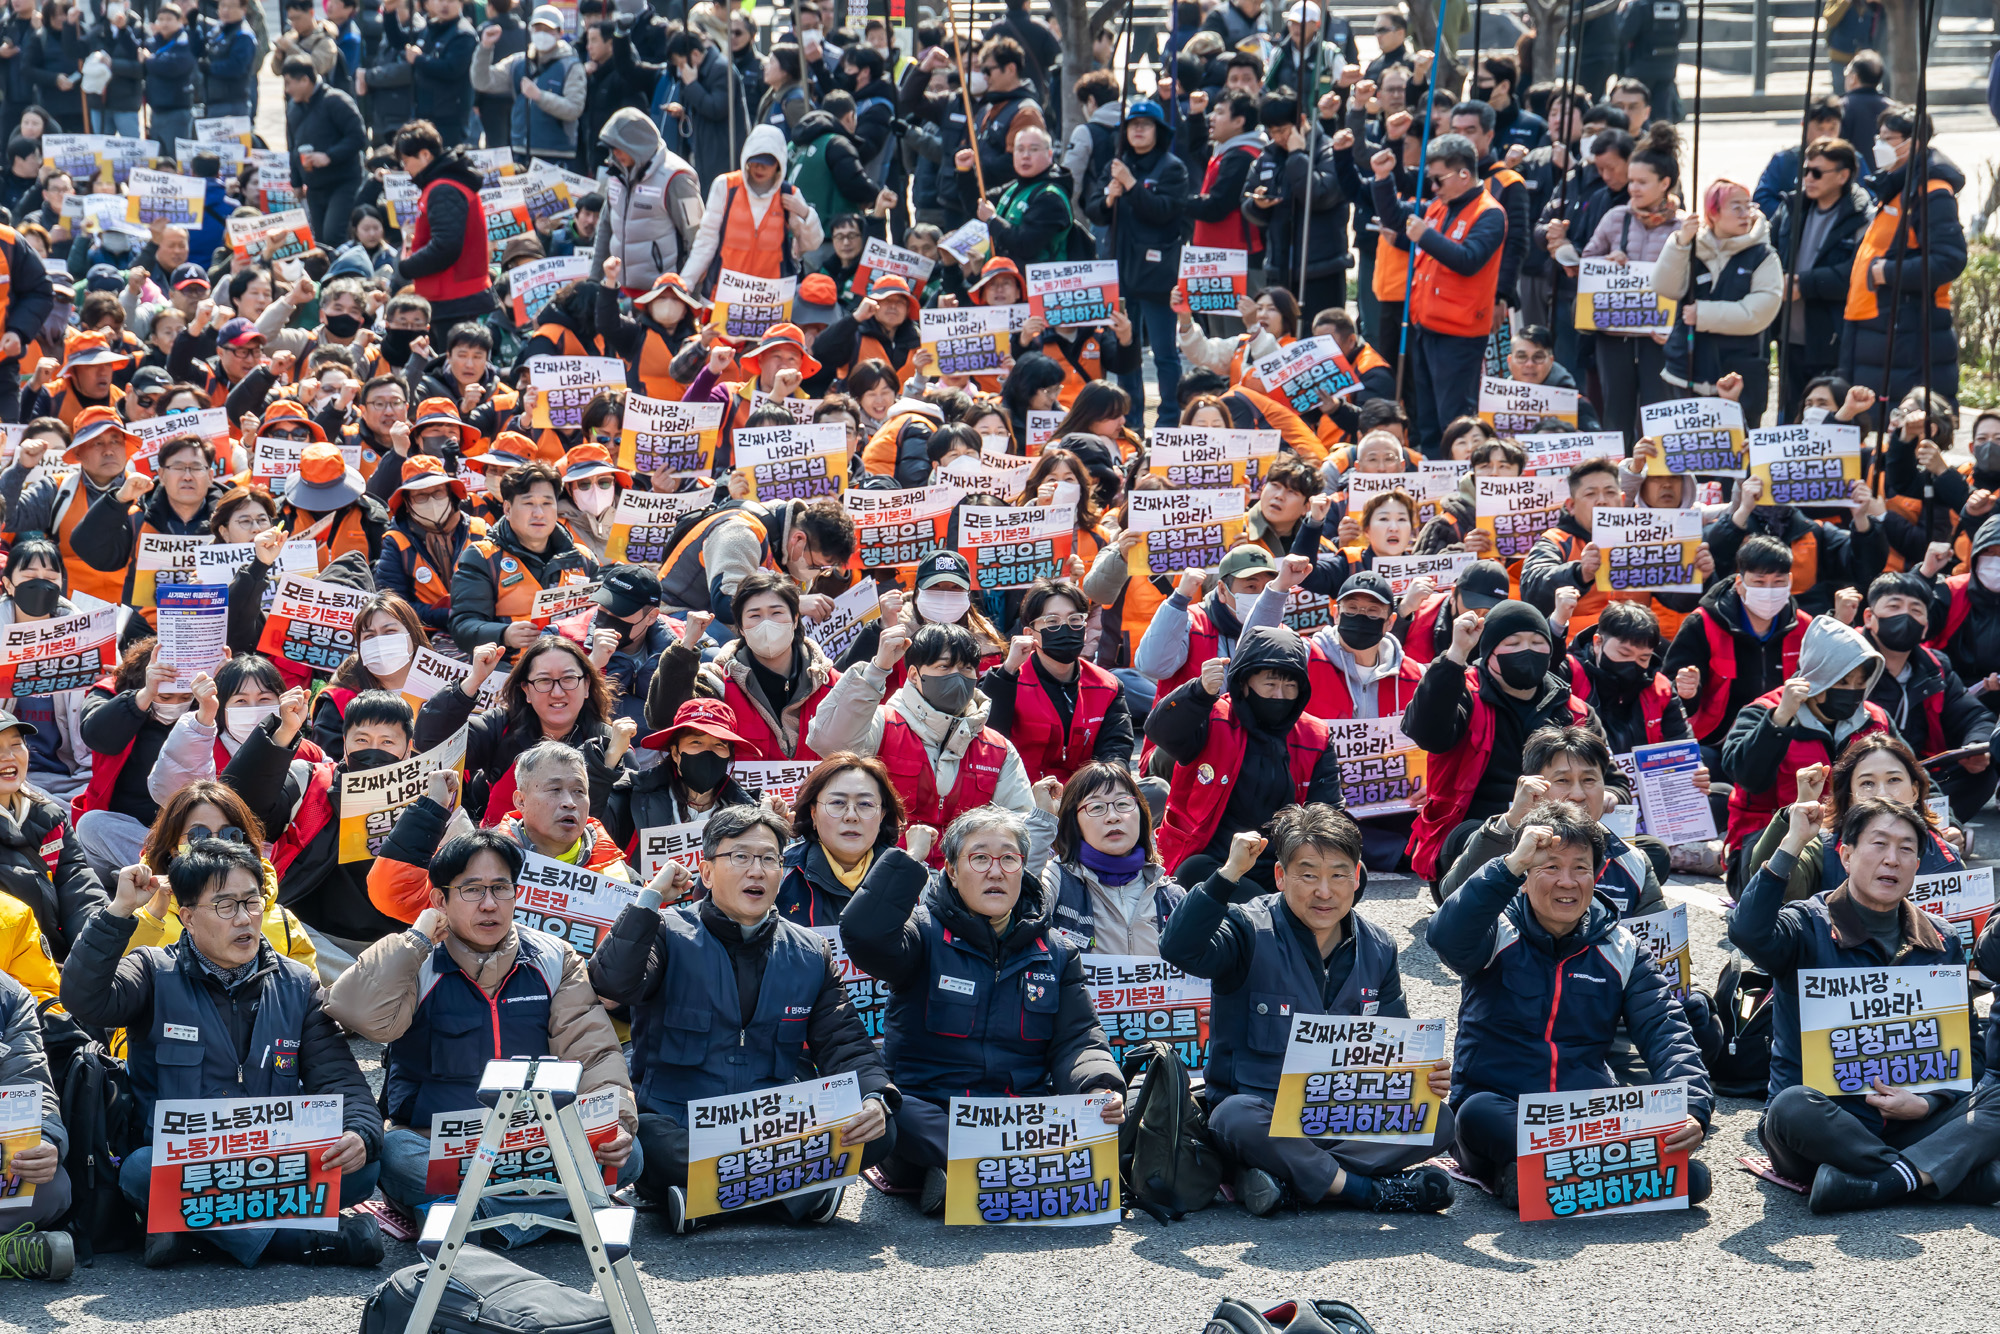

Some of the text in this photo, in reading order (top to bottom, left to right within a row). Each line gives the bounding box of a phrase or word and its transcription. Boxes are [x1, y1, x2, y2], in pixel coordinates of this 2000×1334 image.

[1185, 251, 1228, 264] 모든 노동자의
[1031, 264, 1093, 280] 모든 노동자의
[1583, 262, 1630, 276] 진짜사장
[722, 274, 768, 291] 진짜사장
[1033, 276, 1082, 291] 노동기본권
[1187, 276, 1233, 293] 투쟁으로
[1607, 276, 1650, 291] 나와라!
[742, 291, 780, 304] 나와라!
[1043, 287, 1104, 308] 투쟁으로
[1188, 292, 1241, 312] 쟁취하자!
[1592, 292, 1657, 309] 원청교섭
[727, 303, 783, 321] 원청교섭
[924, 312, 970, 326] 진짜사장
[1045, 303, 1113, 327] 쟁취하자!
[1593, 309, 1668, 328] 쟁취하자!
[727, 320, 772, 337] 쟁취하
[947, 321, 988, 337] 나와라!
[936, 335, 995, 354] 원청교섭
[534, 360, 582, 374] 진짜사장
[938, 354, 1005, 376] 쟁취하자!
[1261, 358, 1282, 376] 모든
[560, 370, 601, 386] 나와라!
[1282, 359, 1340, 396] 투쟁으로
[1485, 382, 1531, 398] 진짜사장
[629, 398, 679, 420] 진짜사장
[1507, 399, 1550, 412] 나와라!
[1646, 401, 1700, 421] 진짜사장
[156, 415, 199, 433] 노동자의
[650, 415, 696, 434] 나와라!
[1031, 417, 1051, 430] 모든
[1675, 412, 1722, 431] 나와라!
[635, 431, 700, 455] 원청교섭
[738, 430, 792, 446] 진짜사장
[1156, 432, 1208, 446] 진짜사장
[1547, 435, 1594, 452] 노동자의
[1660, 431, 1731, 454] 원청교섭
[1753, 428, 1809, 446] 진짜사장
[260, 445, 284, 460] 모든
[767, 440, 815, 460] 나와라!
[1182, 446, 1226, 462] 나와라!
[1783, 441, 1832, 457] 나와라!
[634, 451, 707, 473] 쟁취하자!
[754, 456, 826, 484] 원청교섭
[1660, 449, 1742, 474] 쟁취하자!
[1769, 458, 1843, 480] 원청교섭
[940, 472, 993, 489] 진짜사장
[1168, 464, 1232, 484] 원청교섭
[1354, 477, 1406, 492] 진짜사장
[757, 476, 840, 501] 쟁취하자!
[1481, 481, 1535, 496] 진짜사장
[1771, 478, 1856, 502] 쟁취하자!
[624, 494, 678, 510] 진짜사장
[849, 491, 925, 510] 모든 노동자의
[1133, 494, 1190, 511] 진짜사장
[1509, 491, 1553, 511] 나와라!
[852, 508, 912, 525] 노동기본권
[964, 509, 1045, 530] 모든 노동자의
[1163, 505, 1212, 526] 나와라!
[1495, 510, 1561, 536] 원청교섭
[1597, 512, 1652, 528] 진짜사장
[860, 520, 934, 546] 투쟁으로
[967, 526, 1030, 545] 노동기본권
[1148, 525, 1223, 552] 원청교섭
[1626, 527, 1674, 543] 나와라!
[860, 537, 946, 567] 쟁취하자!
[977, 538, 1053, 566] 투쟁으로
[1148, 546, 1227, 574] 쟁취하자
[1610, 545, 1681, 570] 원청교섭
[977, 557, 1063, 590] 쟁취하자!
[1378, 558, 1453, 578] 모든 노동자의
[1610, 564, 1694, 590] 쟁취하자!
[282, 581, 313, 602] 모든
[538, 594, 566, 604] 모든
[281, 602, 354, 626] 노동기본권
[6, 614, 91, 648] 모든 노동자의
[287, 620, 358, 651] 투쟁으
[815, 608, 853, 643] 나와라!
[8, 640, 76, 663] 노동기본권
[15, 648, 101, 680] 투쟁으로
[1337, 734, 1395, 758] 나와라!
[347, 761, 421, 794] 진짜사장
[1342, 755, 1406, 784] 청교섭
[1341, 777, 1421, 806] 취하자!
[647, 835, 684, 855] 모든
[521, 861, 596, 894] 노동자의
[517, 884, 570, 912] 기본권
[614, 885, 639, 898] 민주노총
[1117, 962, 1186, 985] 노동자의
[1938, 969, 1961, 977] 민주노총
[1805, 971, 1889, 999] 진짜사장
[1093, 985, 1166, 1010] 동기본권
[1850, 989, 1923, 1020] 나와라!
[1099, 1007, 1198, 1042] 투쟁으로
[1295, 1020, 1376, 1044] 진짜사장
[1830, 1018, 1940, 1059] 원청교섭
[1331, 1042, 1404, 1068] 나와라!
[1833, 1049, 1959, 1092] 쟁취하자!
[831, 1078, 854, 1088] 민주노총
[1304, 1071, 1414, 1105] 원청교섭
[1661, 1088, 1683, 1097] 민주노총
[9, 1090, 37, 1099] 민주노총
[311, 1100, 338, 1109] 민주노총
[588, 1093, 615, 1104] 민주노총
[161, 1101, 293, 1135] 모든 노동자의
[695, 1094, 782, 1129] 진짜사장
[956, 1103, 1046, 1132] 진짜사장
[1523, 1090, 1644, 1126] 모든 노동자의
[438, 1119, 484, 1138] 모든
[740, 1105, 817, 1146] 나와라!
[1300, 1103, 1427, 1135] 쟁취하자!
[444, 1126, 547, 1157] 노동본권
[1002, 1119, 1078, 1152] 나와라!
[1530, 1116, 1621, 1151] 노동기본권
[167, 1129, 269, 1162] 노동기본권
[717, 1132, 831, 1183] 원청교섭
[1544, 1137, 1658, 1181] 투쟁으로
[182, 1152, 307, 1194] 투쟁으로
[977, 1147, 1093, 1190] 원청교섭
[717, 1151, 848, 1209] 쟁취하자!
[976, 1178, 1110, 1224] 쟁취하자!
[1547, 1166, 1676, 1217] 쟁취하자!
[182, 1183, 326, 1228] 쟁취하자!
